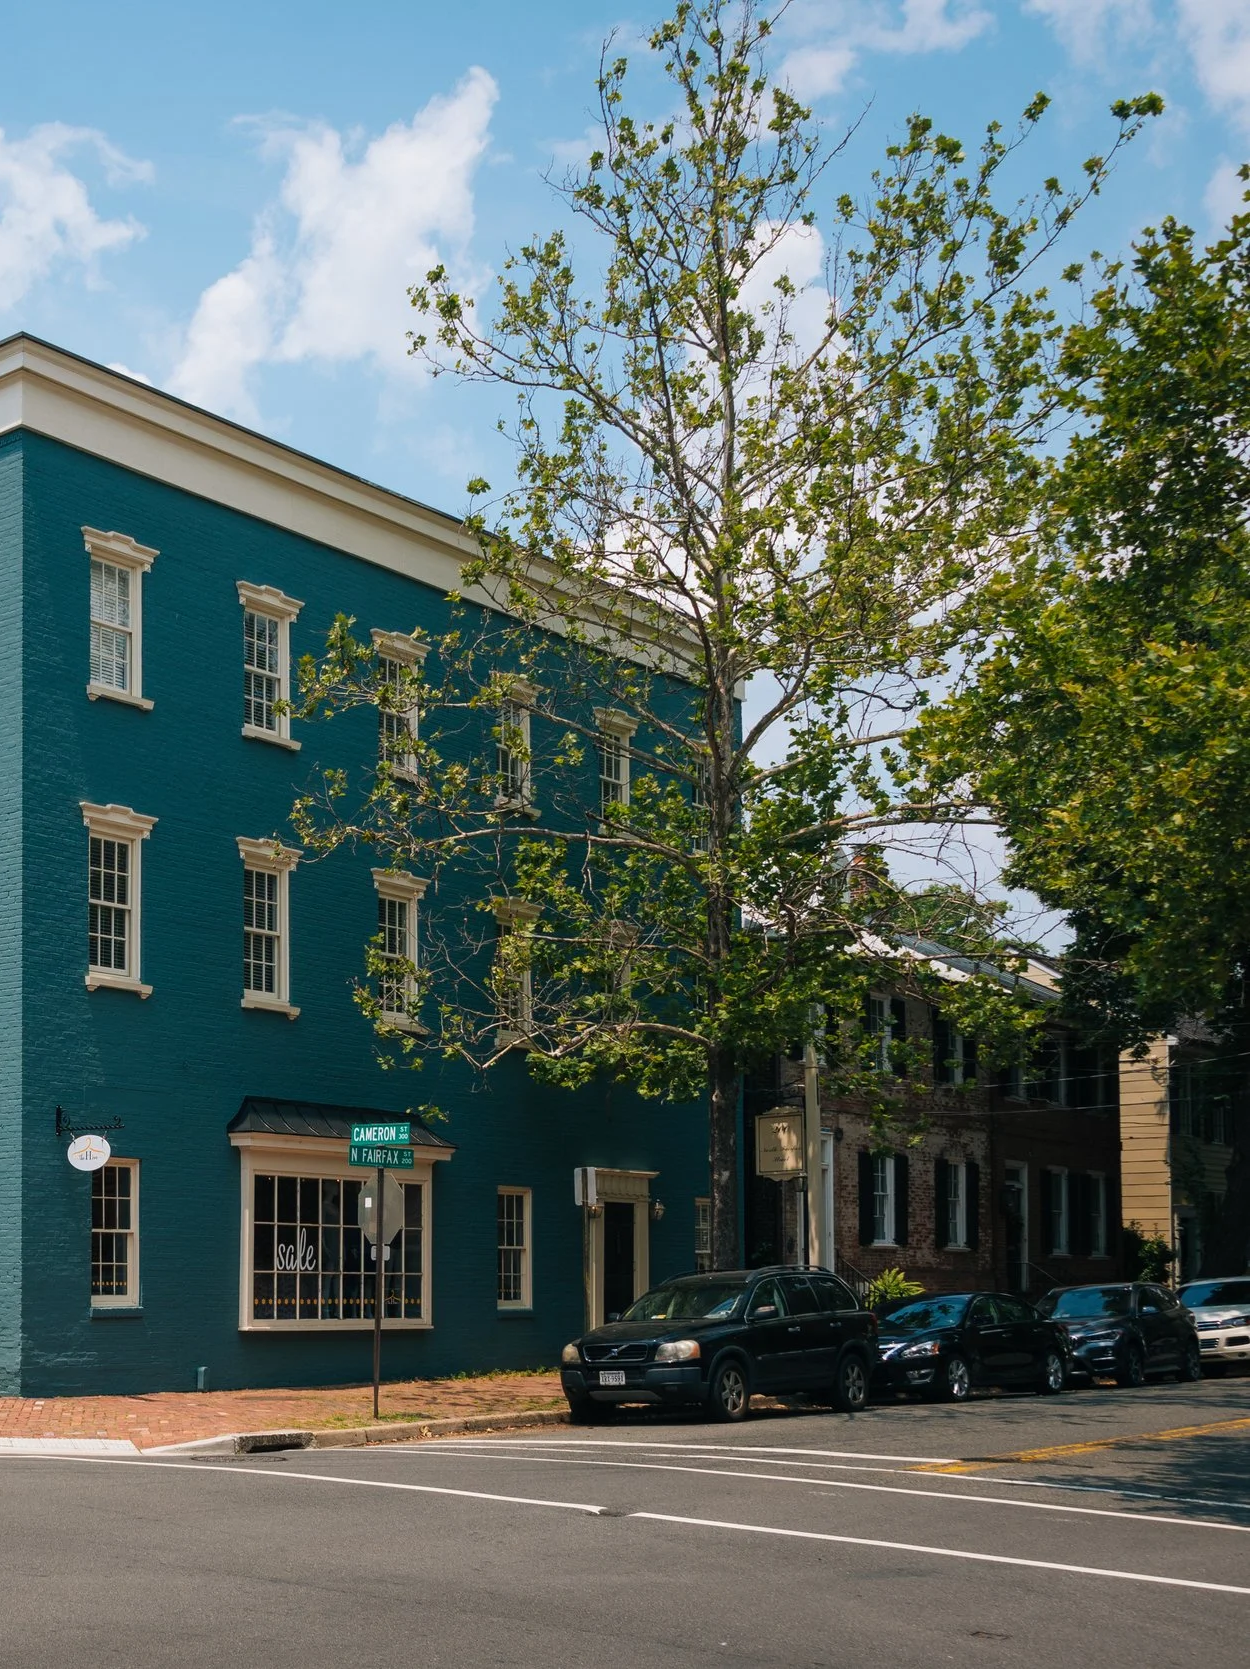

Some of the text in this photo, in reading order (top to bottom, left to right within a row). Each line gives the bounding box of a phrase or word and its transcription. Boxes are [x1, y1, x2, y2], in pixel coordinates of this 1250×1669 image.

[353, 1127, 396, 1141] CAMERON
[351, 1148, 357, 1162] N
[362, 1148, 399, 1164] FAIRFAX
[277, 1227, 316, 1270] sale
